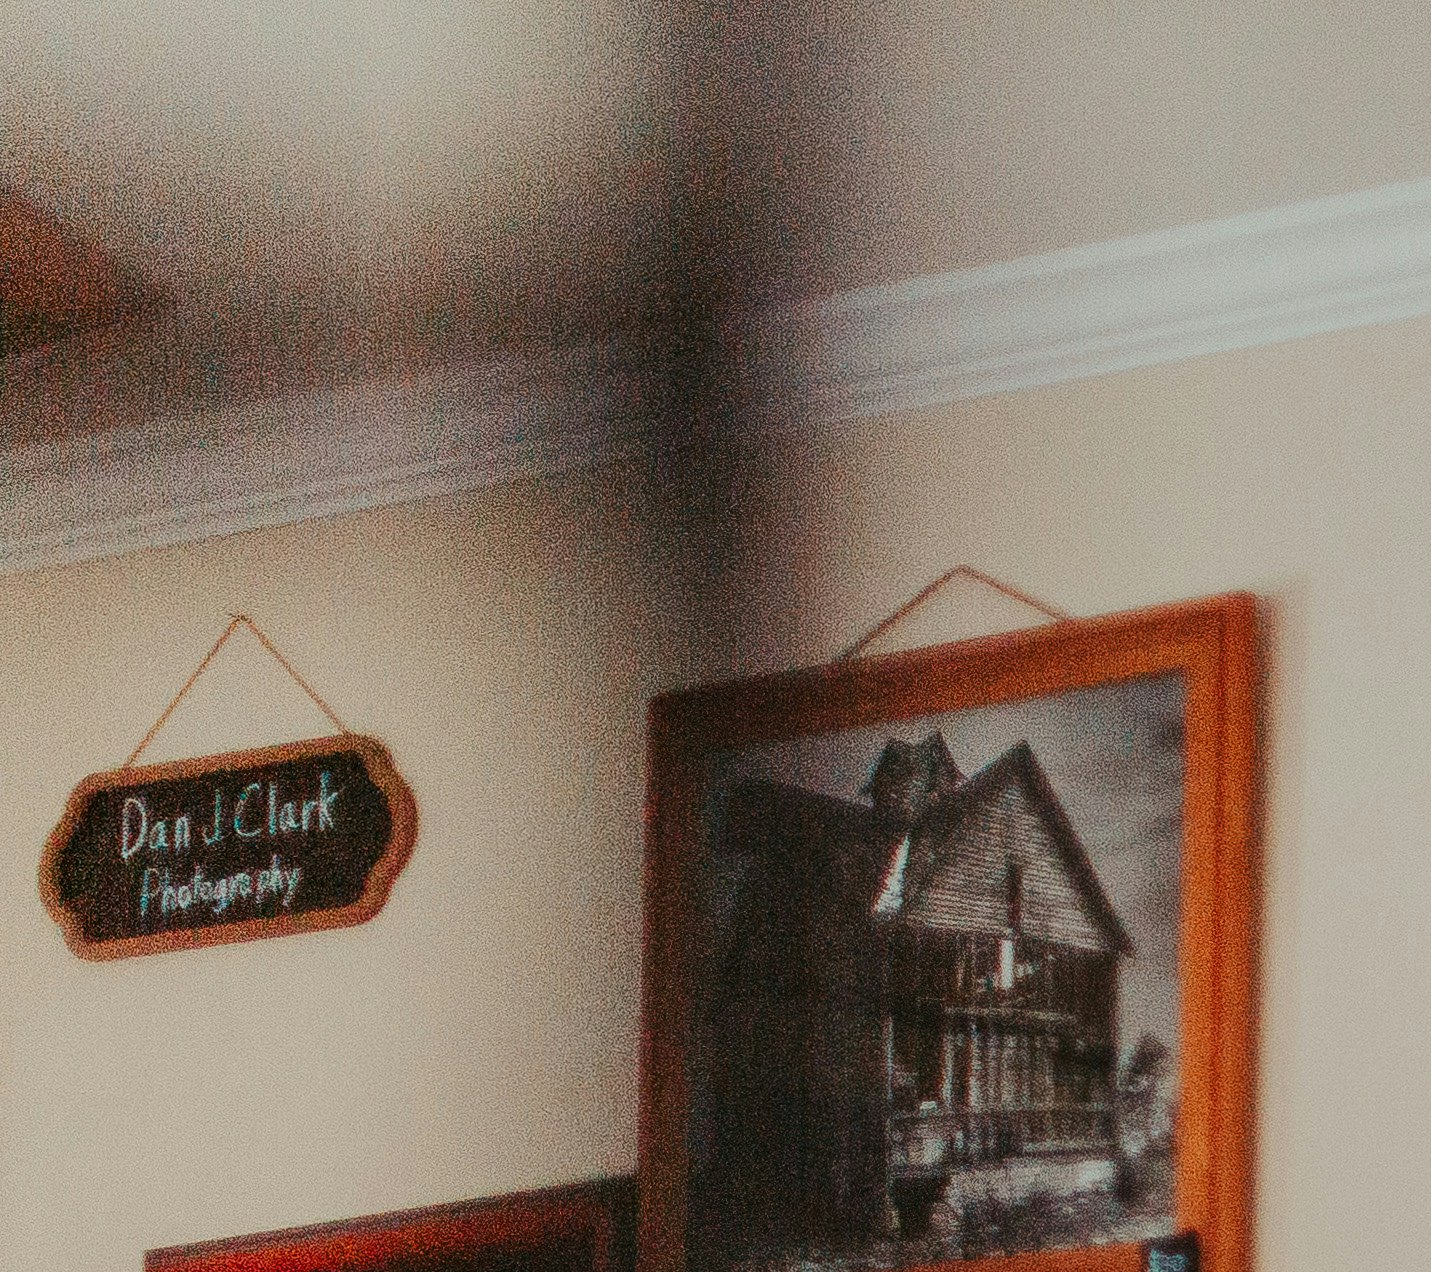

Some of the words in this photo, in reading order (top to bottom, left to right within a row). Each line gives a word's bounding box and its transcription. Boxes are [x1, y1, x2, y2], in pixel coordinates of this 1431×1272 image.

[121, 797, 190, 860] Dan
[203, 788, 222, 845] J
[234, 769, 338, 837] Clark
[139, 854, 302, 917] Photography
